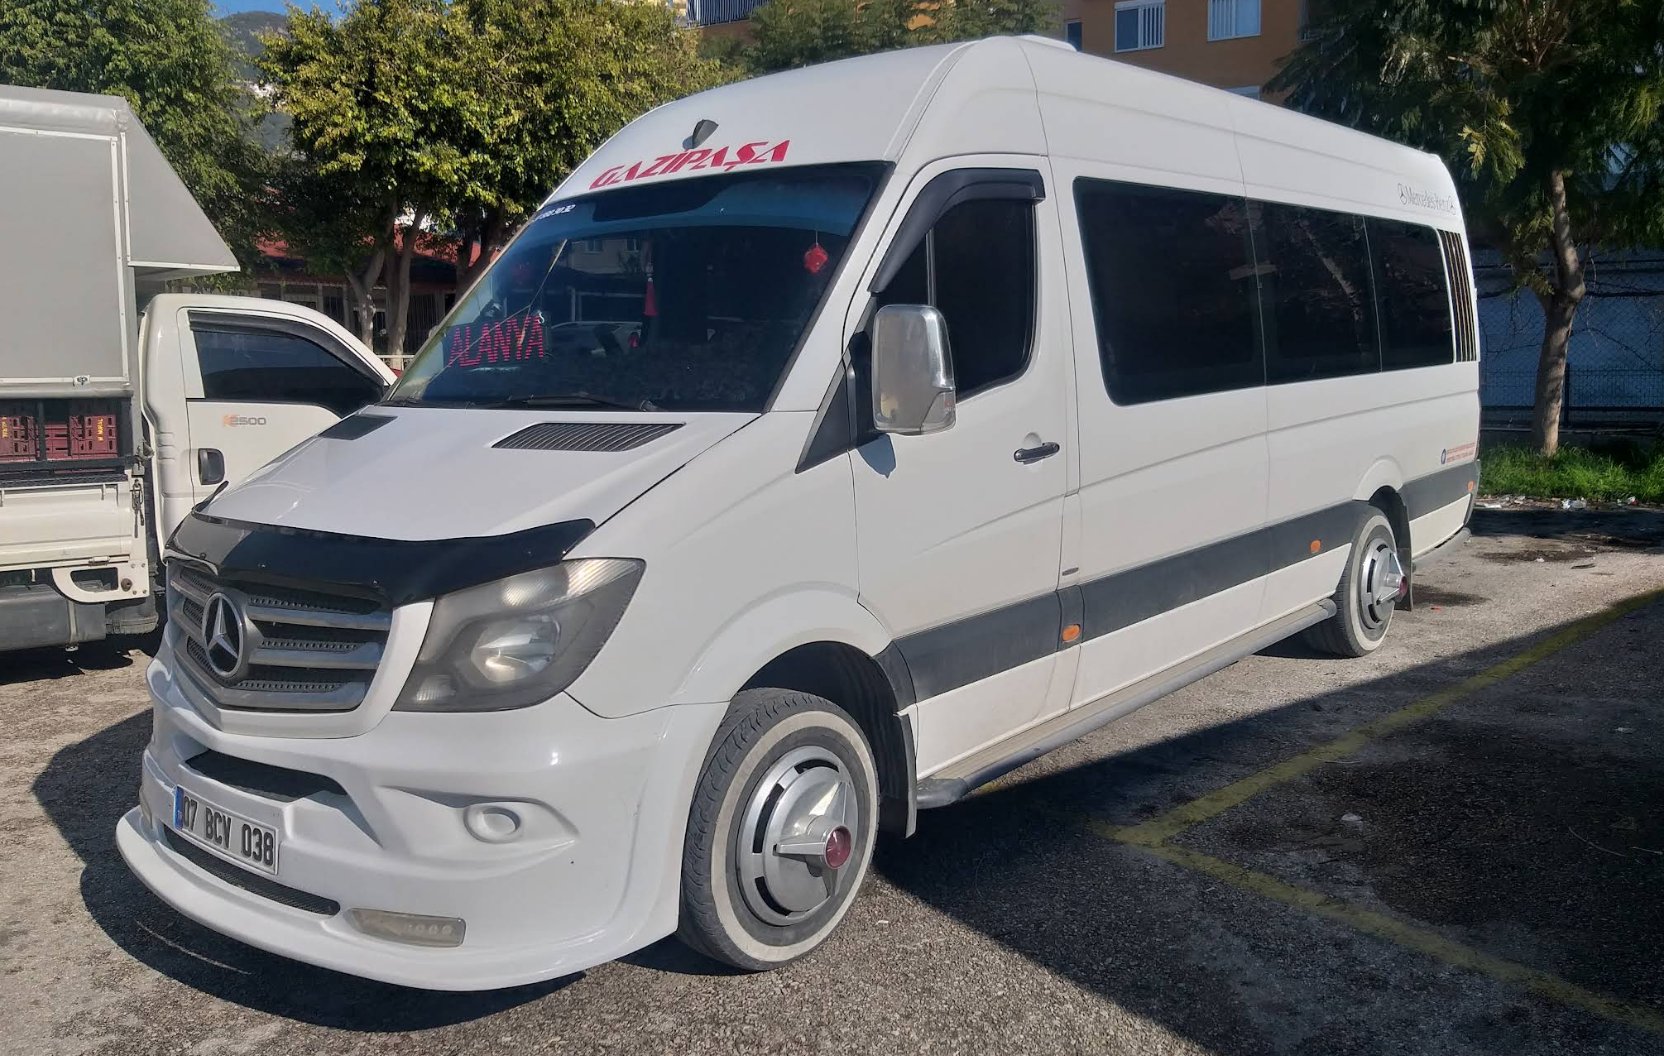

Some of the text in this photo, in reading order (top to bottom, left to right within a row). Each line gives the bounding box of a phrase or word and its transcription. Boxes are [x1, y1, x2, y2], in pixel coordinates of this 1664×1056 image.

[589, 140, 790, 190] GAZİPAŞA
[448, 314, 544, 368] ALANYA
[183, 796, 275, 866] 07 BCV 038
